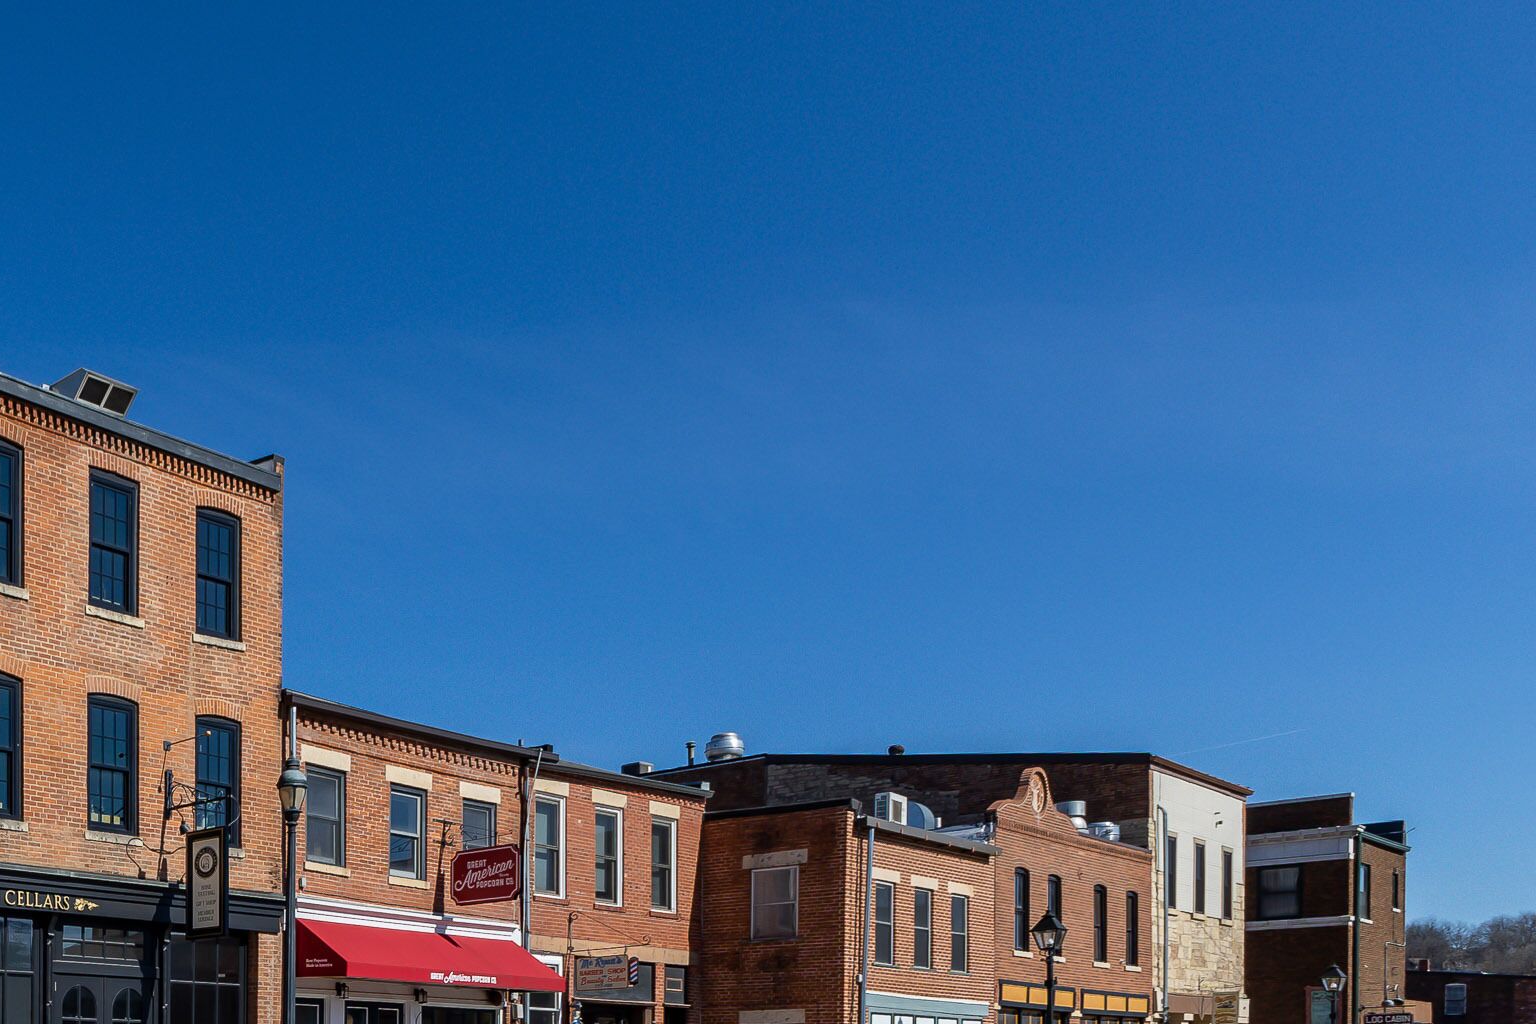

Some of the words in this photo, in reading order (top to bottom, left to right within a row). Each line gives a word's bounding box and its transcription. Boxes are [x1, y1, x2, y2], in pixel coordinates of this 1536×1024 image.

[467, 859, 487, 869] GREAT
[454, 860, 515, 891] American
[476, 879, 504, 888] POPCORN
[5, 890, 70, 911] CELLARS
[1365, 1015, 1384, 1024] LOG
[1384, 1015, 1411, 1023] CABIN
